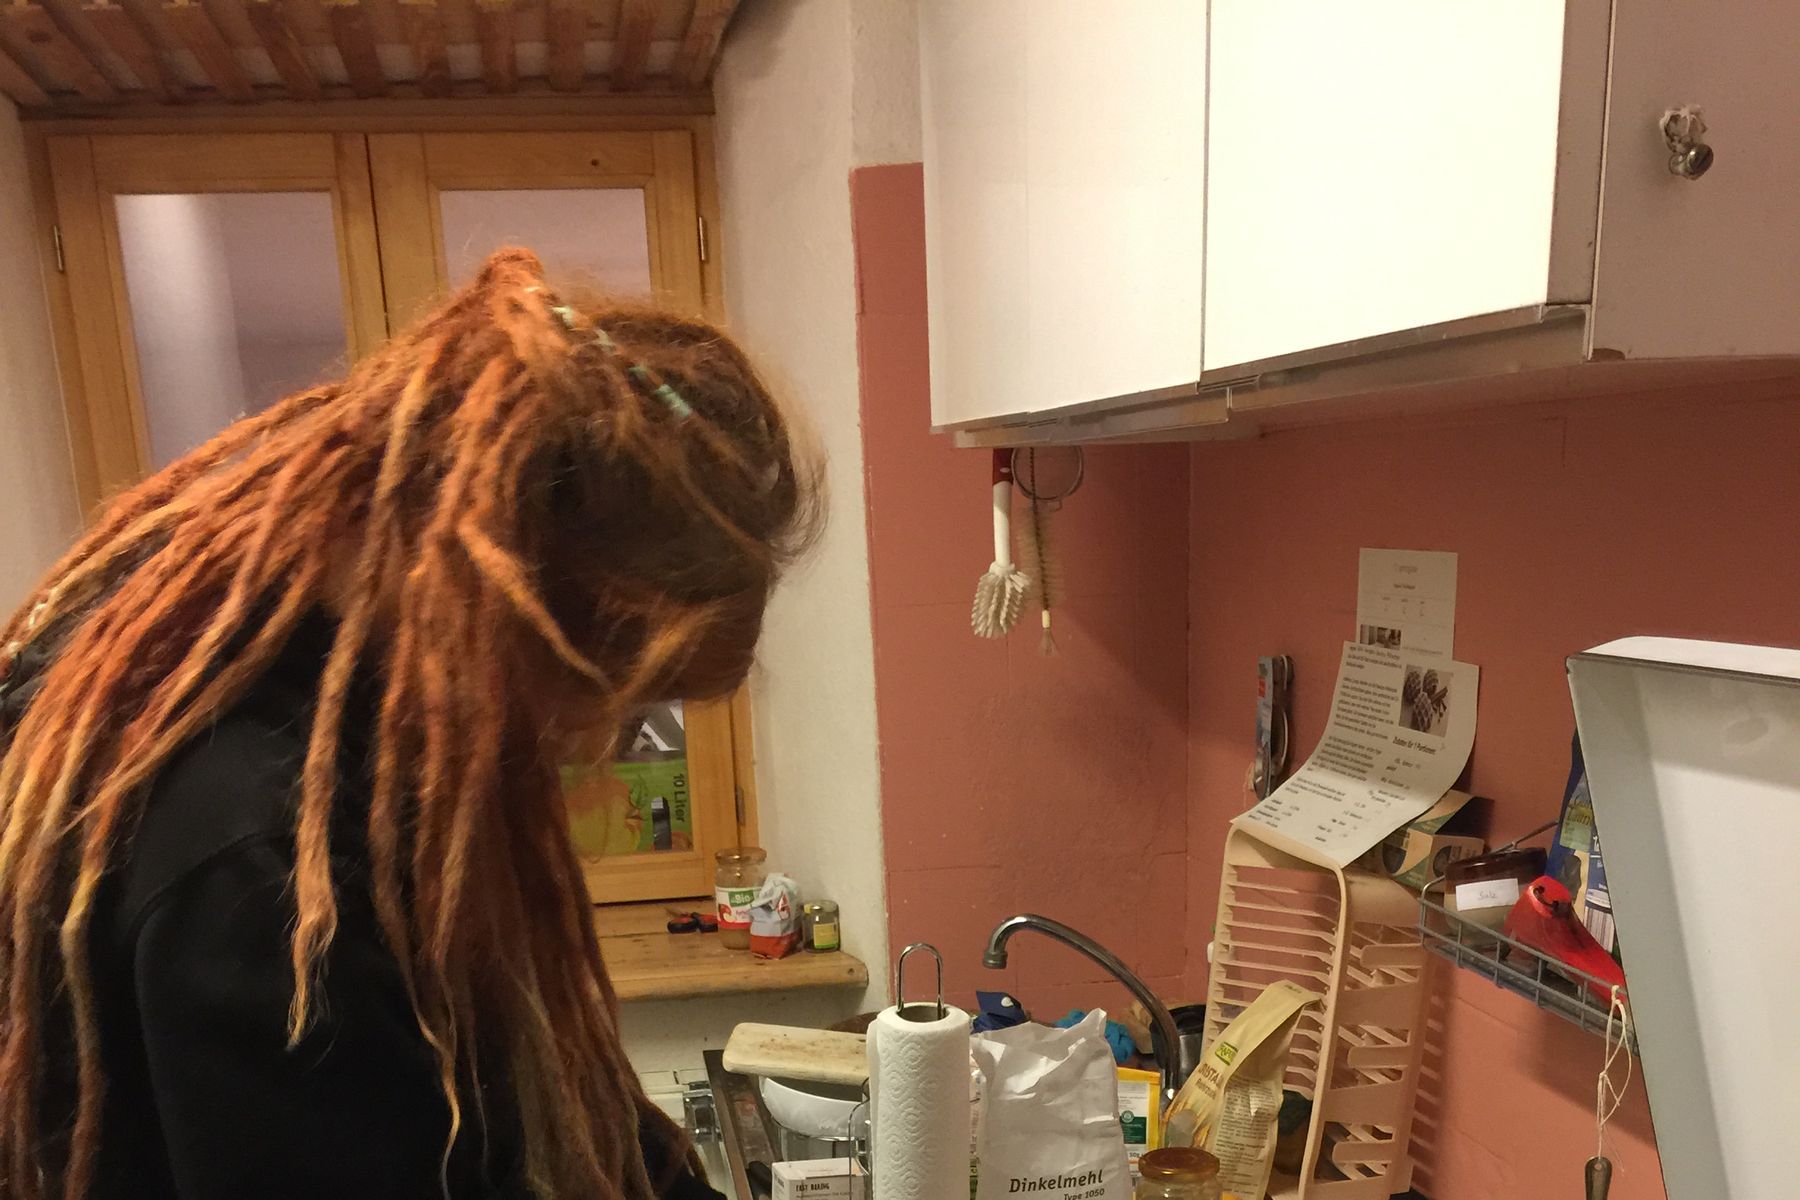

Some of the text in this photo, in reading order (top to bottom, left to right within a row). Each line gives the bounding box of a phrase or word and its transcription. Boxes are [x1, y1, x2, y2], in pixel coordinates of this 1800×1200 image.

[673, 774, 686, 822] 10 Liter
[1008, 1169, 1103, 1193] Dinkelmehl
[1085, 1188, 1105, 1199] 1050
